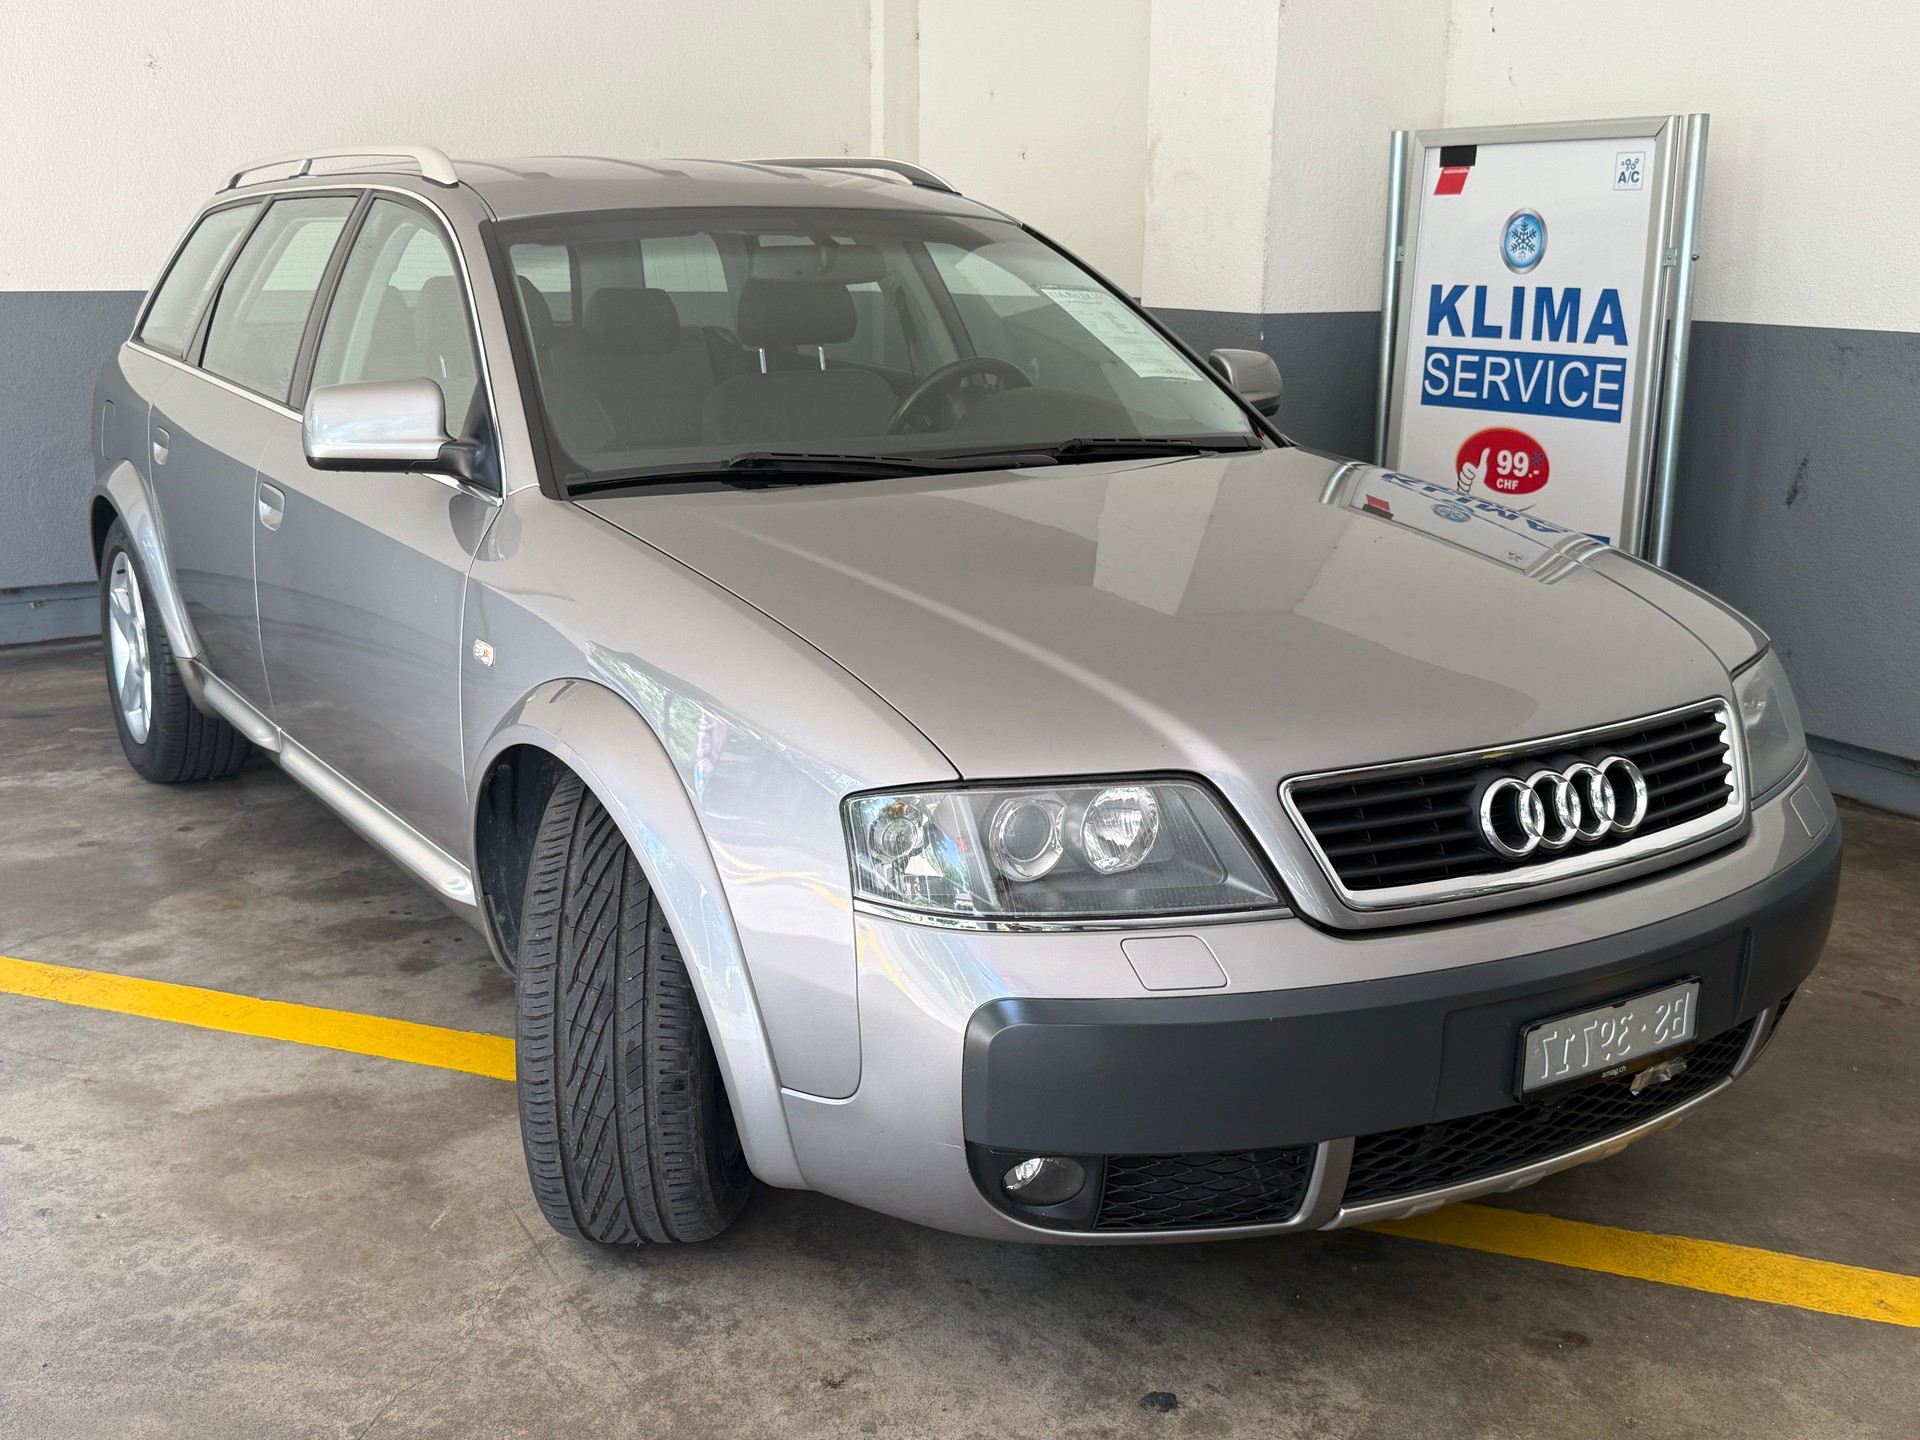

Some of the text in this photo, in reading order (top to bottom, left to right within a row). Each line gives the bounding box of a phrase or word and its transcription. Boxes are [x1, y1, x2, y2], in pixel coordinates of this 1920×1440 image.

[1617, 170, 1640, 184] A/C
[1427, 284, 1629, 346] KLIMA
[1424, 353, 1622, 411] SERVICE
[1496, 478, 1519, 490] CHF
